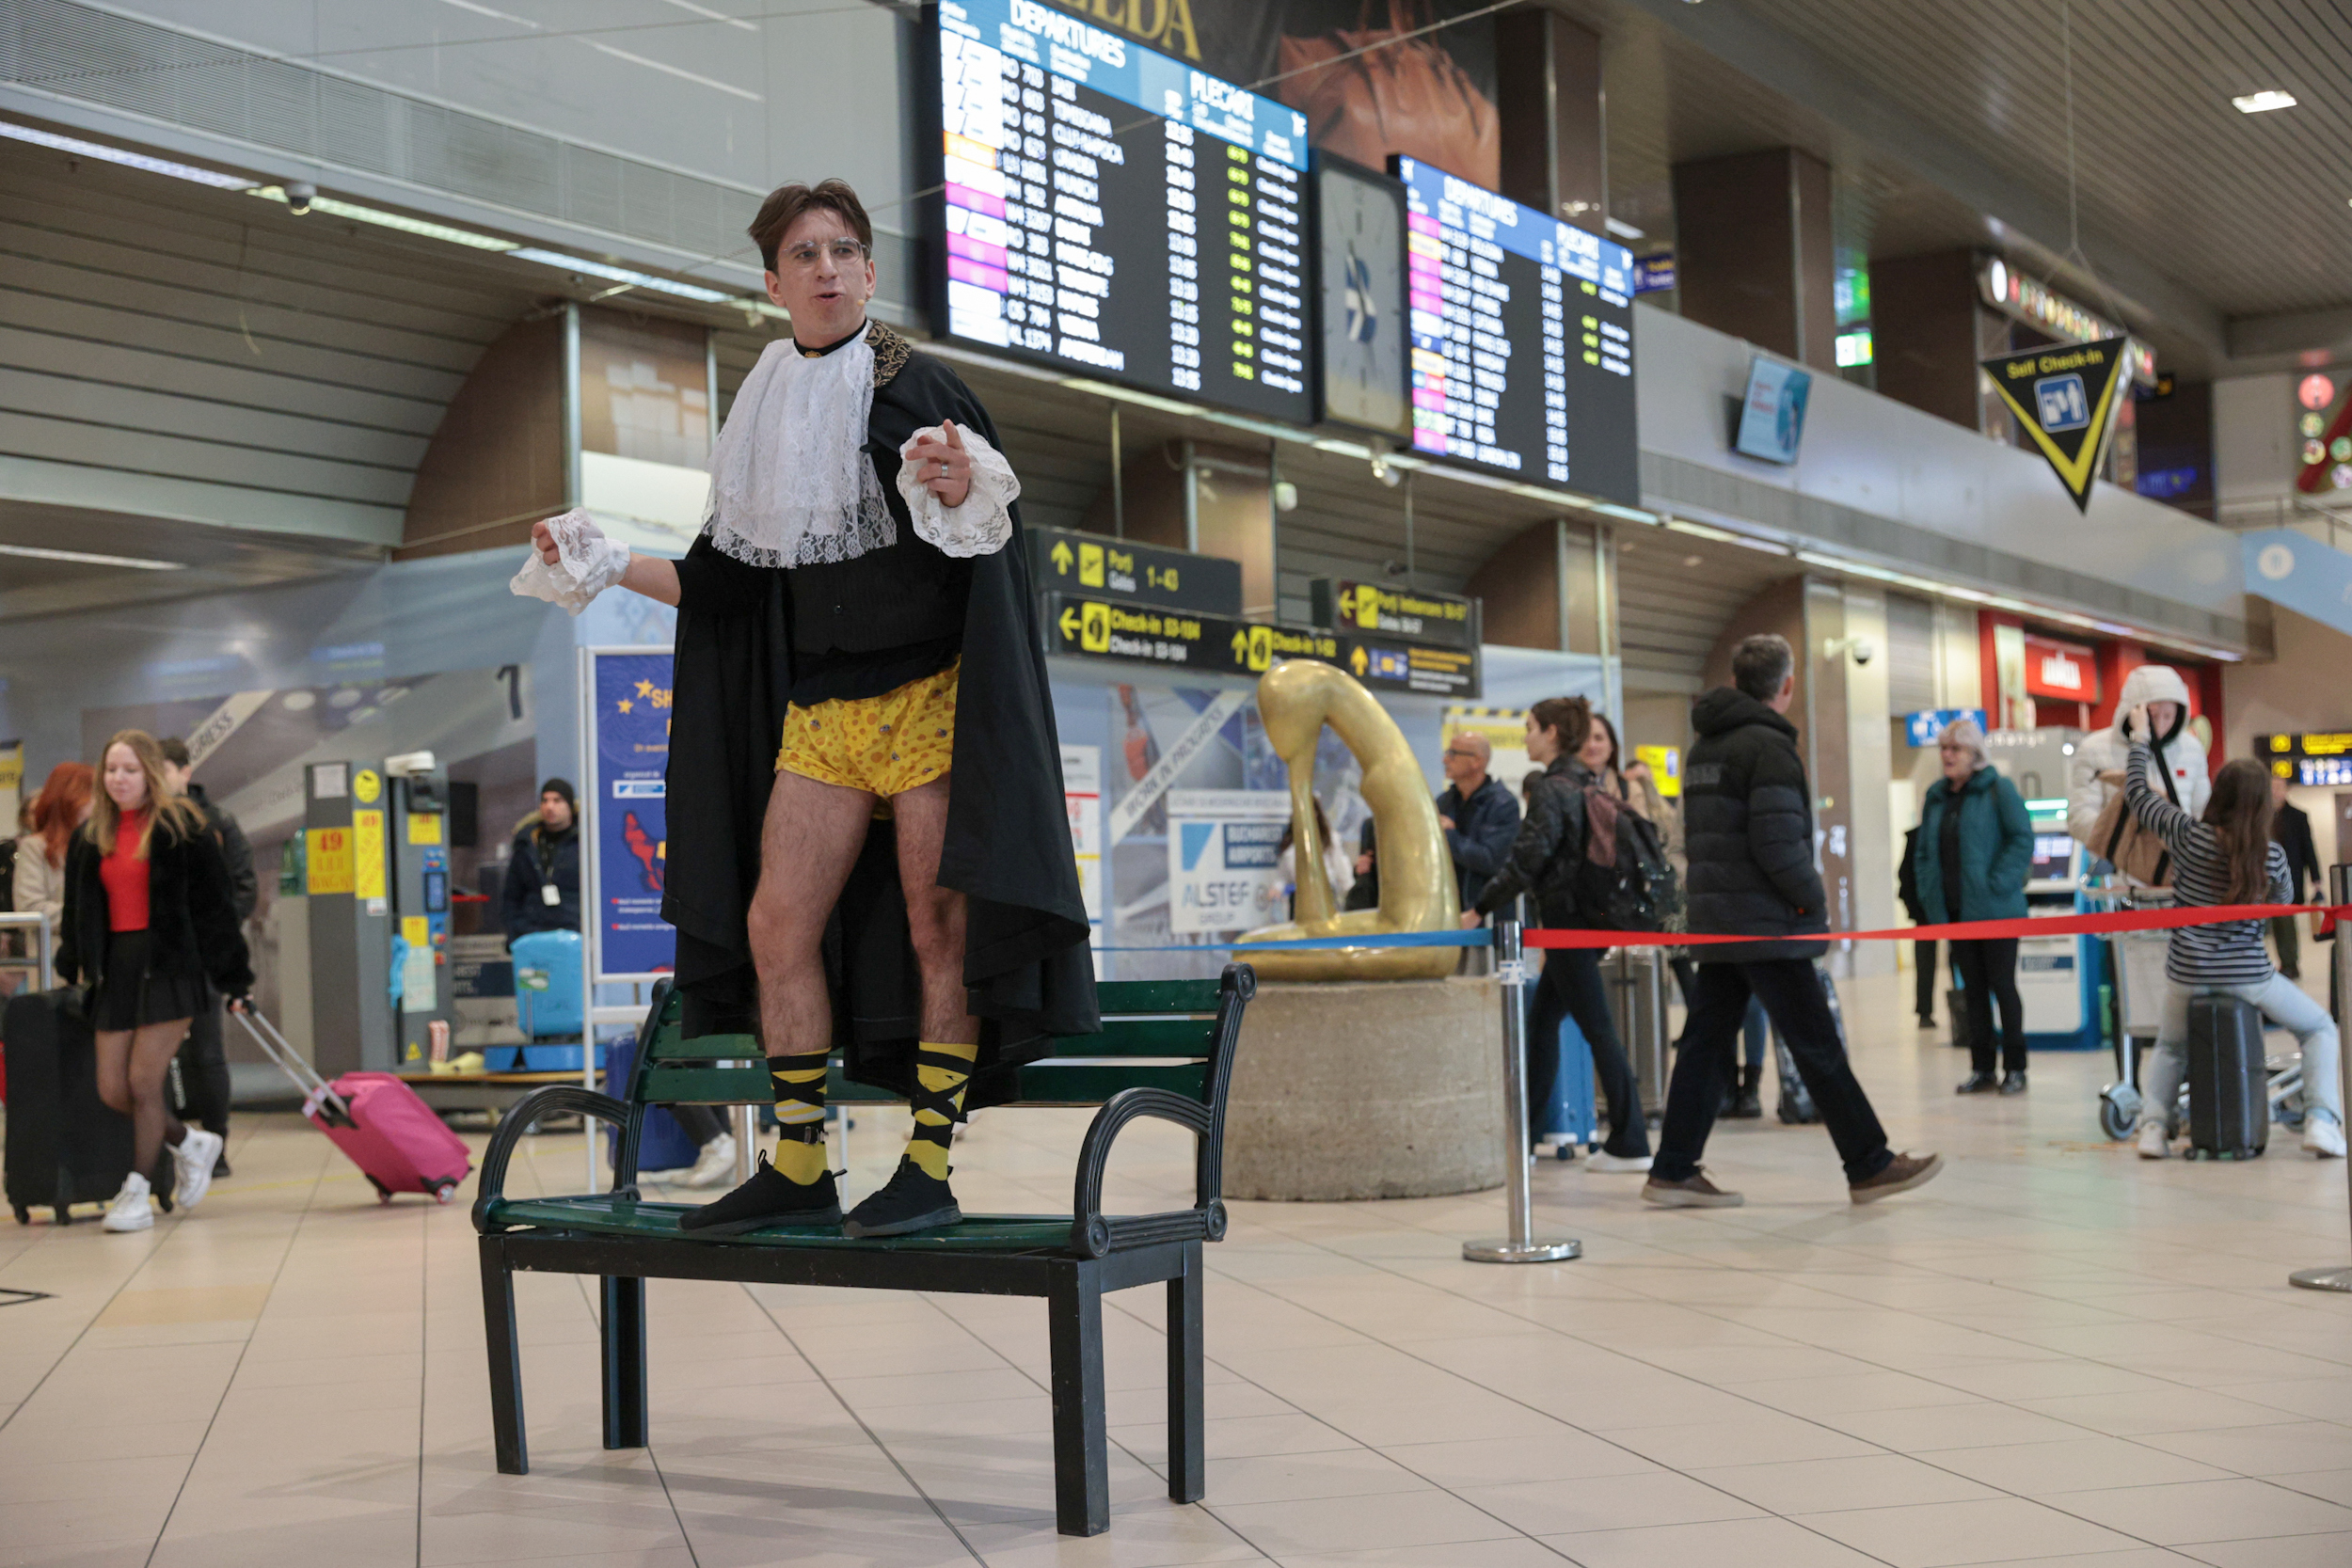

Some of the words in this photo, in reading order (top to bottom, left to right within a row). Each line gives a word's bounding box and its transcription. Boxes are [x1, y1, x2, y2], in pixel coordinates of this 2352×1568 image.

[1009, 0, 1126, 68] DEPARTURES
[2006, 358, 2037, 380] Self
[1227, 826, 1282, 843] BUCHAREST
[1227, 847, 1279, 864] AIRPORTS
[1183, 881, 1249, 909] ALSTEF
